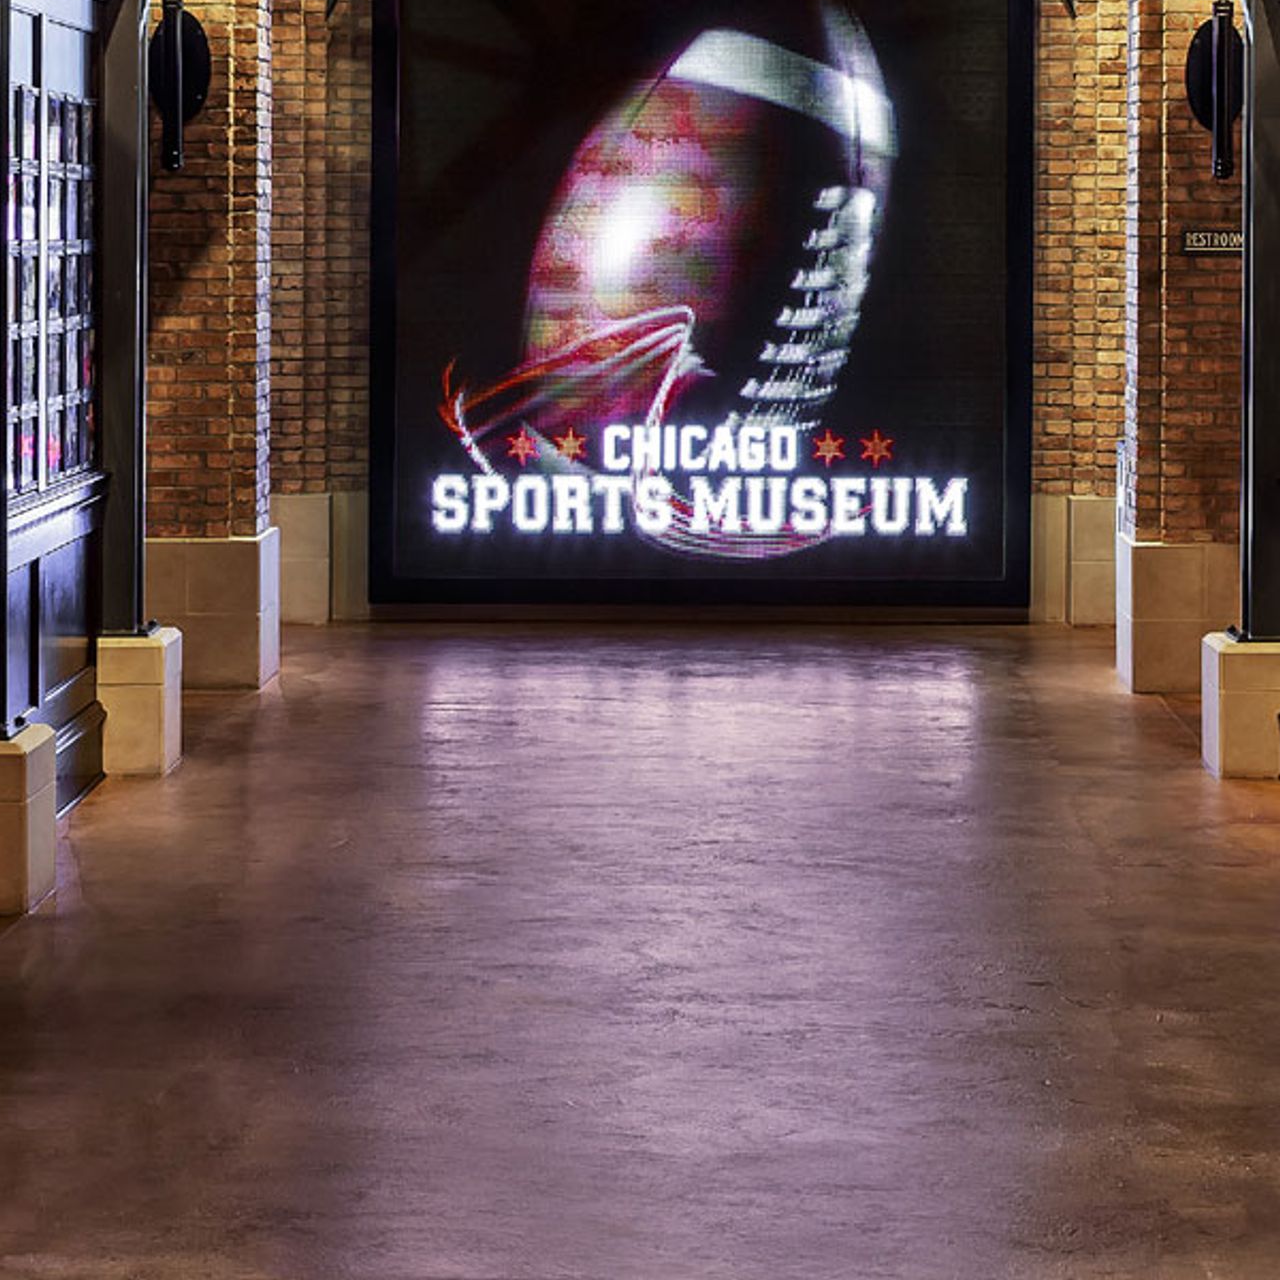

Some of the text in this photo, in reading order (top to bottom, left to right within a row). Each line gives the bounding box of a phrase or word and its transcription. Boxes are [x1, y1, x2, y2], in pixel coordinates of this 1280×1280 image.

[602, 425, 799, 471] CHICAGO
[432, 475, 968, 536] SPORTS MUSEUM
